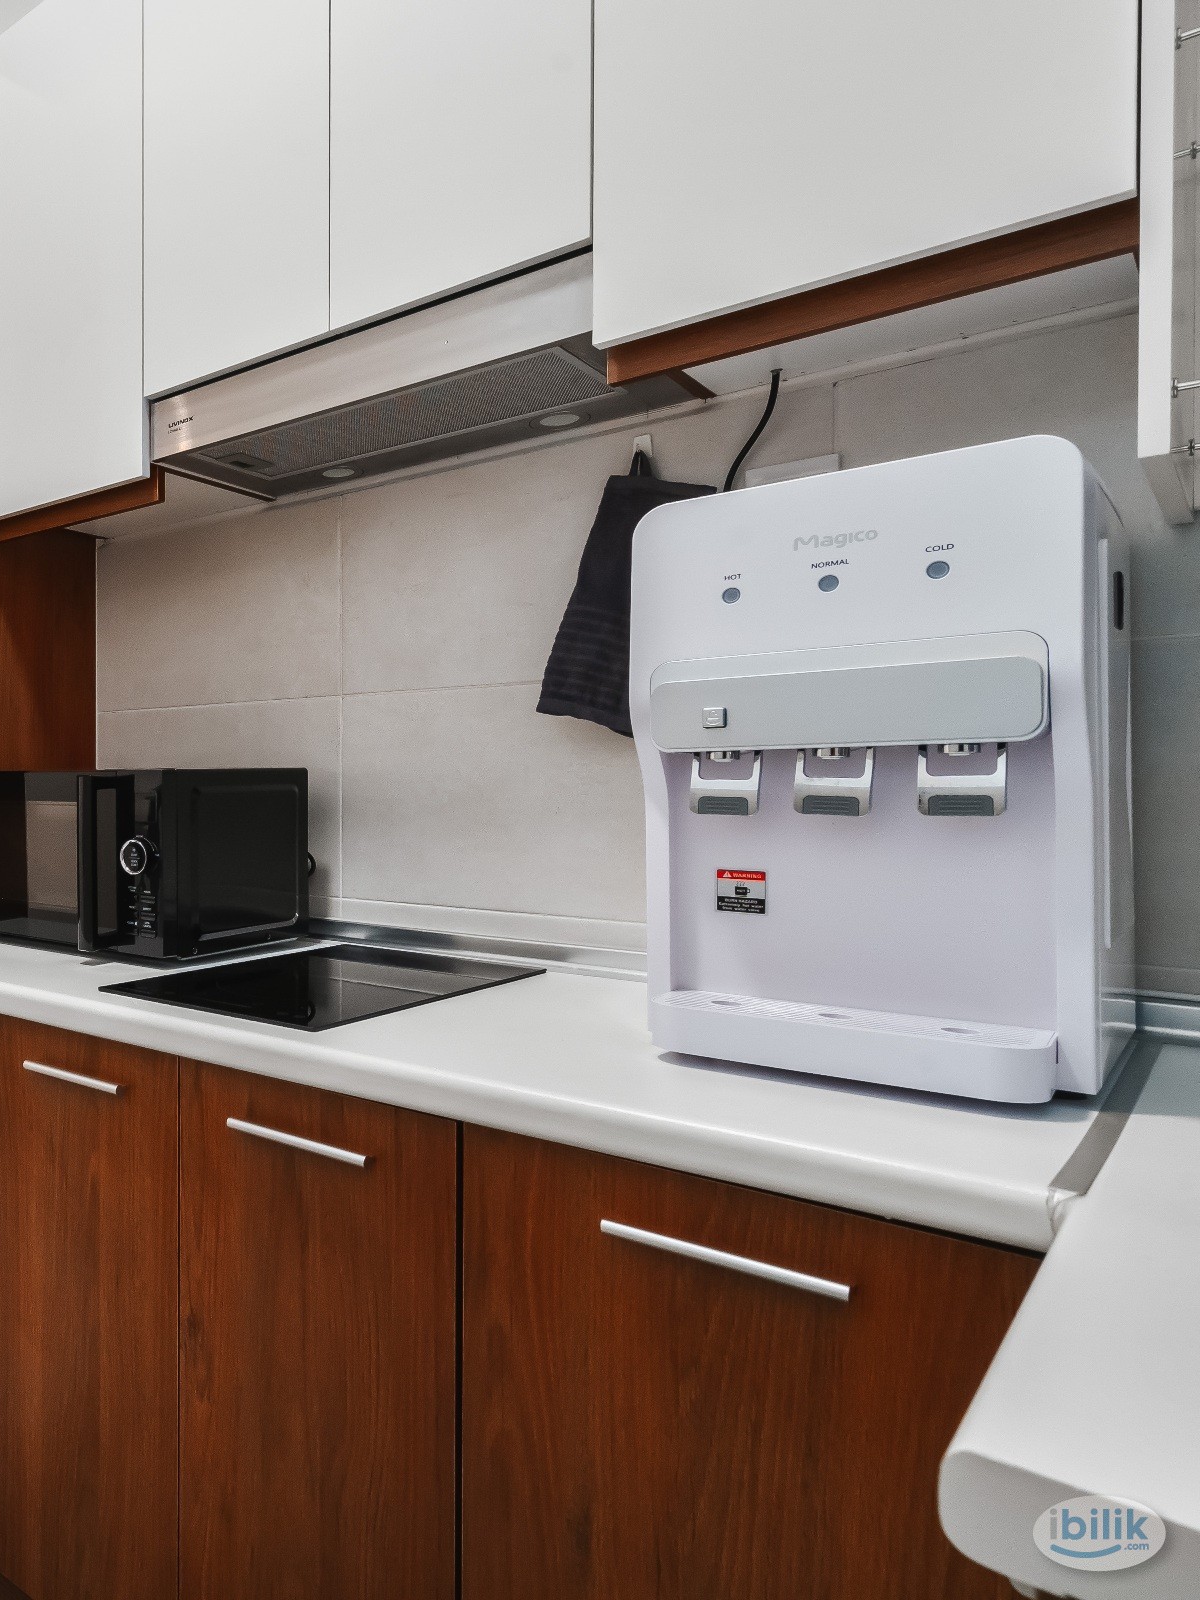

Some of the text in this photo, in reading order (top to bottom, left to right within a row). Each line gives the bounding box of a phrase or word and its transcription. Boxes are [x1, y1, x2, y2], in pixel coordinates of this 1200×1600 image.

[793, 529, 879, 552] Magico
[925, 543, 955, 553] COLD
[811, 558, 850, 570] NORMAL
[724, 573, 742, 581] HOT
